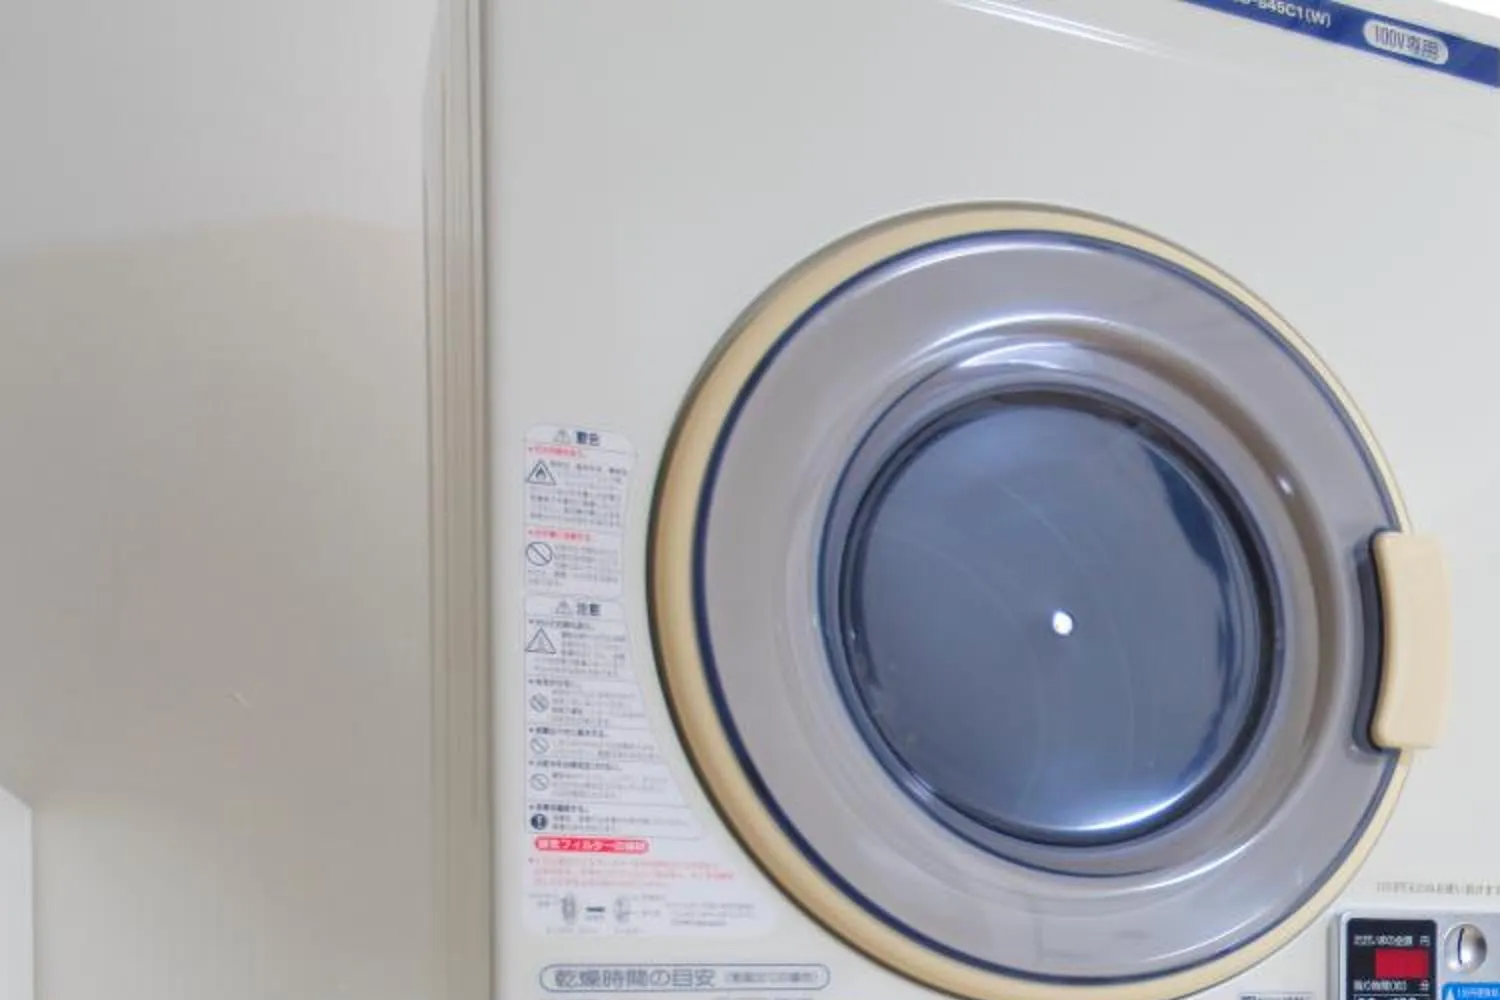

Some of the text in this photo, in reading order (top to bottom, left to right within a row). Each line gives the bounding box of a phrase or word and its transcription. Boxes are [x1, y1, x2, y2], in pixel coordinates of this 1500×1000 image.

[554, 968, 715, 988] 乾燥時間の目安
